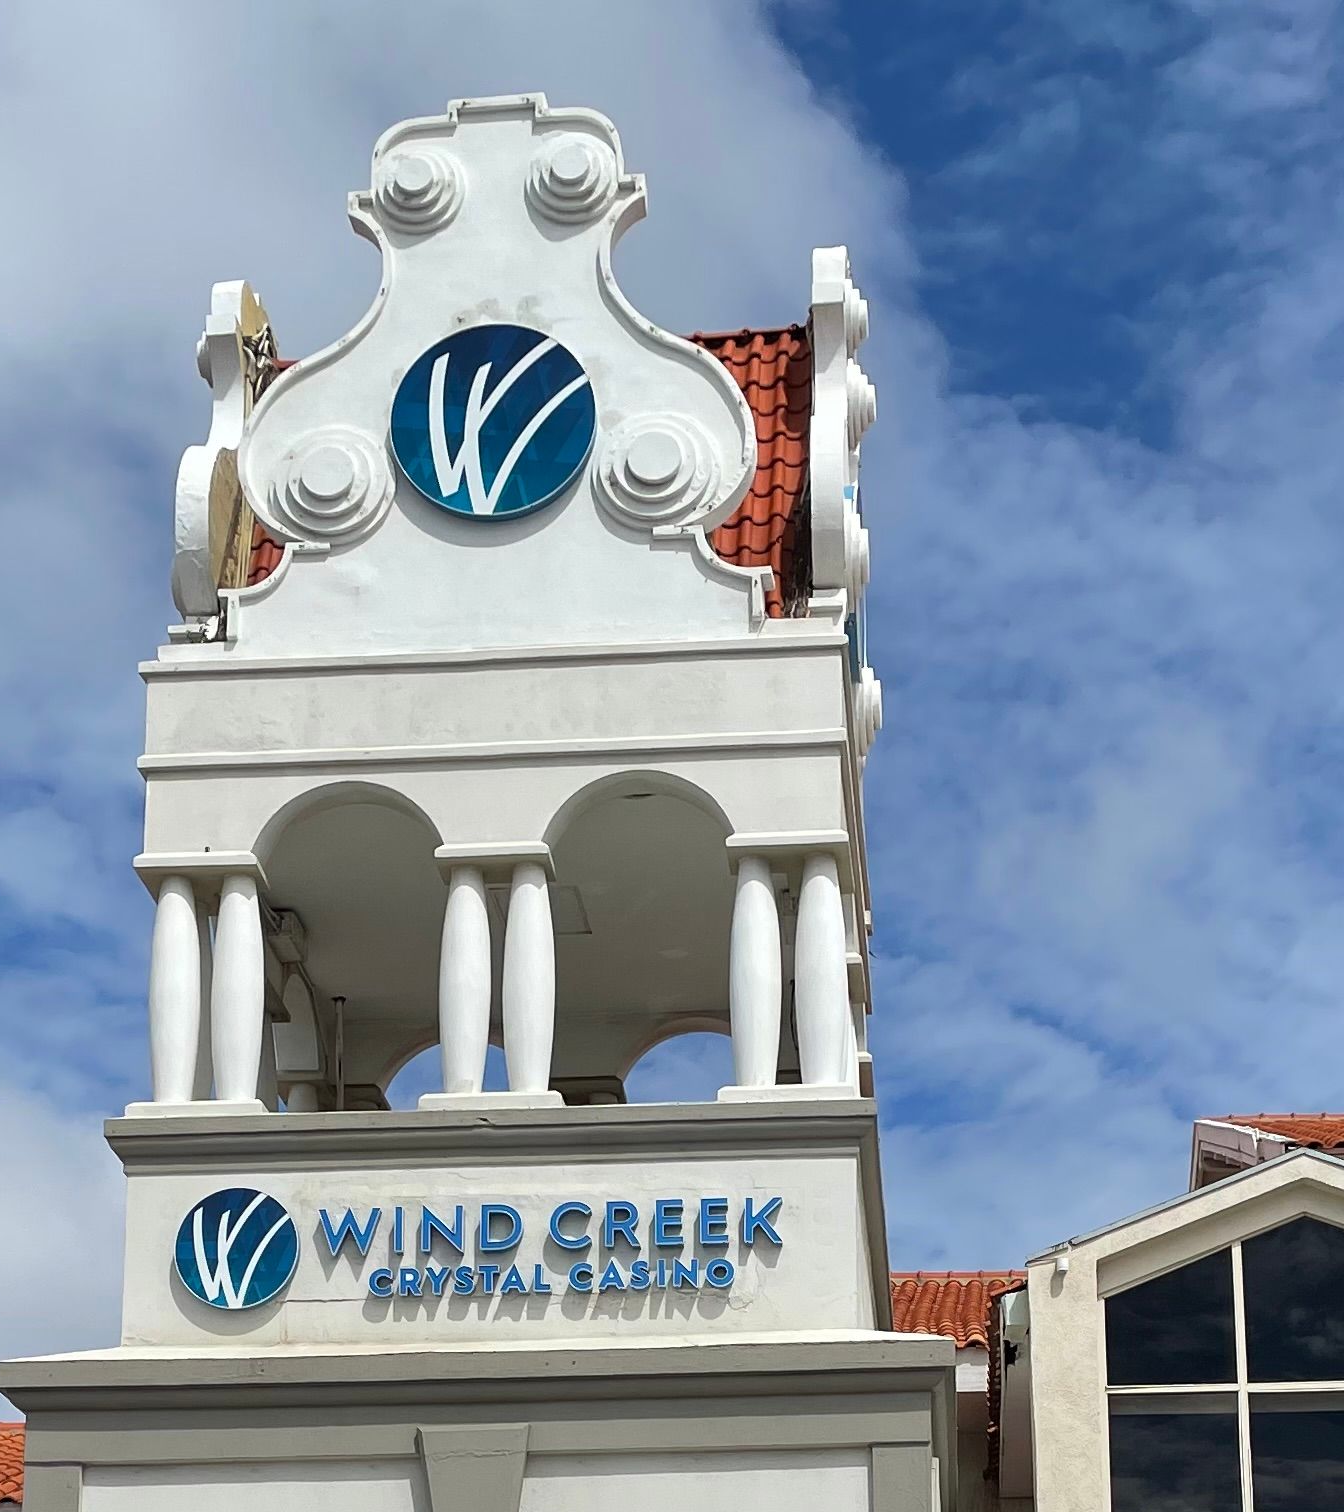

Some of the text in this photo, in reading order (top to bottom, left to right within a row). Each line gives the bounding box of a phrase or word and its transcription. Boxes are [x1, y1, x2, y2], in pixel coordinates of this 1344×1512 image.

[318, 1196, 784, 1257] WIND CREEK
[368, 1257, 735, 1298] CRYSTAL CASINO
